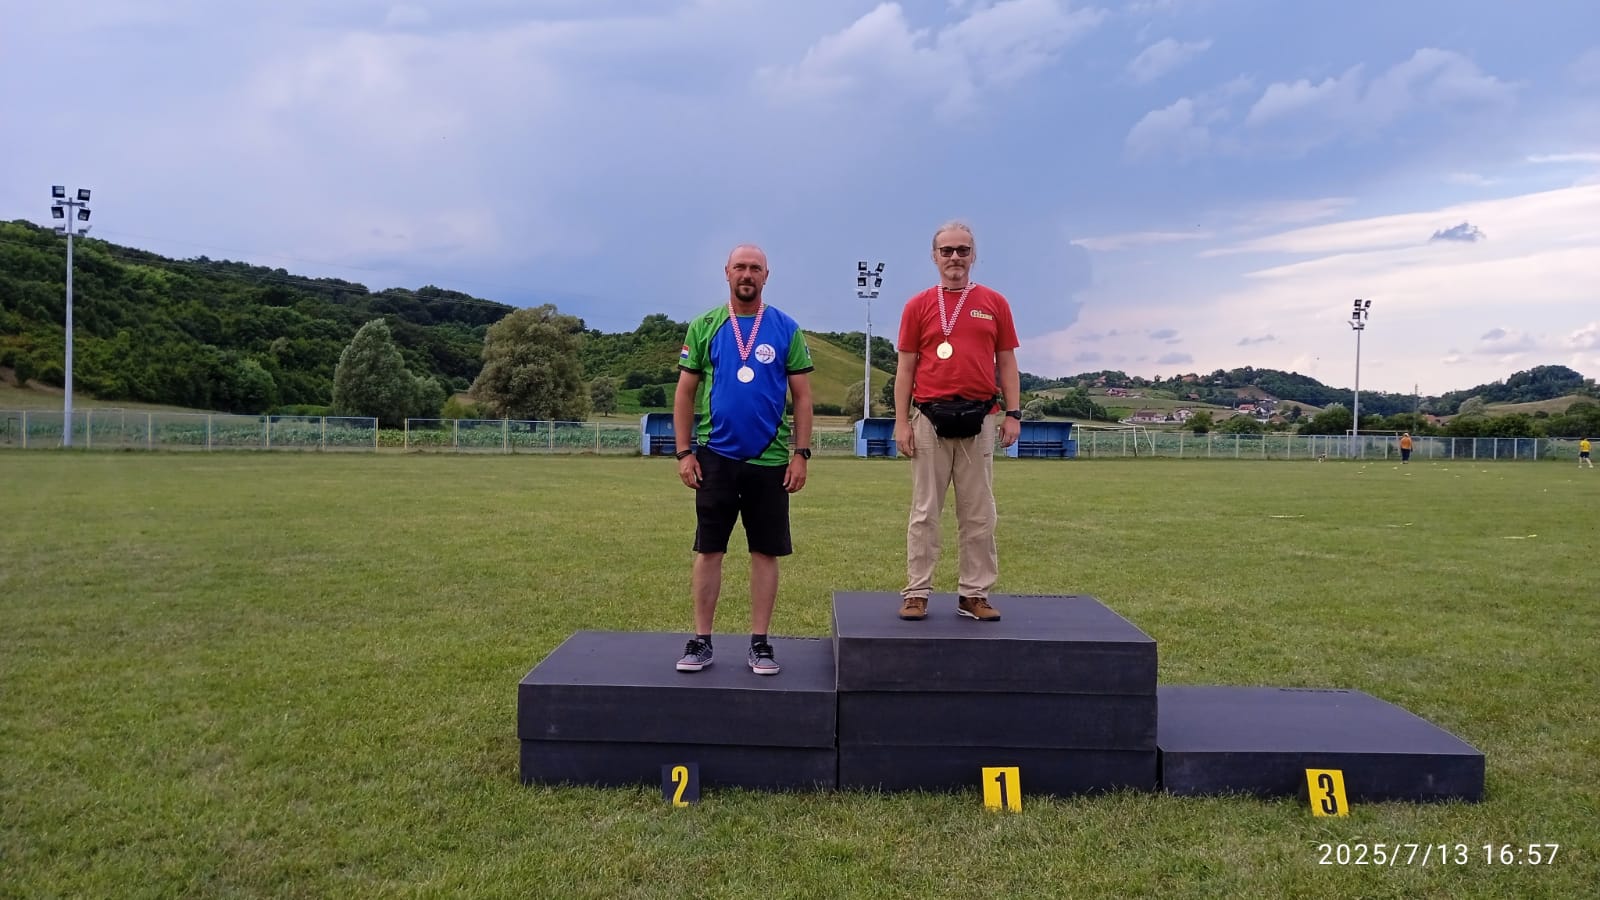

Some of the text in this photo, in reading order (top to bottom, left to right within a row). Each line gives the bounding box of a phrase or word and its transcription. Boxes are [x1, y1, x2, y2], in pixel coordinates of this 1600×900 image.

[672, 766, 689, 807] 2
[995, 772, 1008, 808] 1
[1318, 774, 1338, 814] 3
